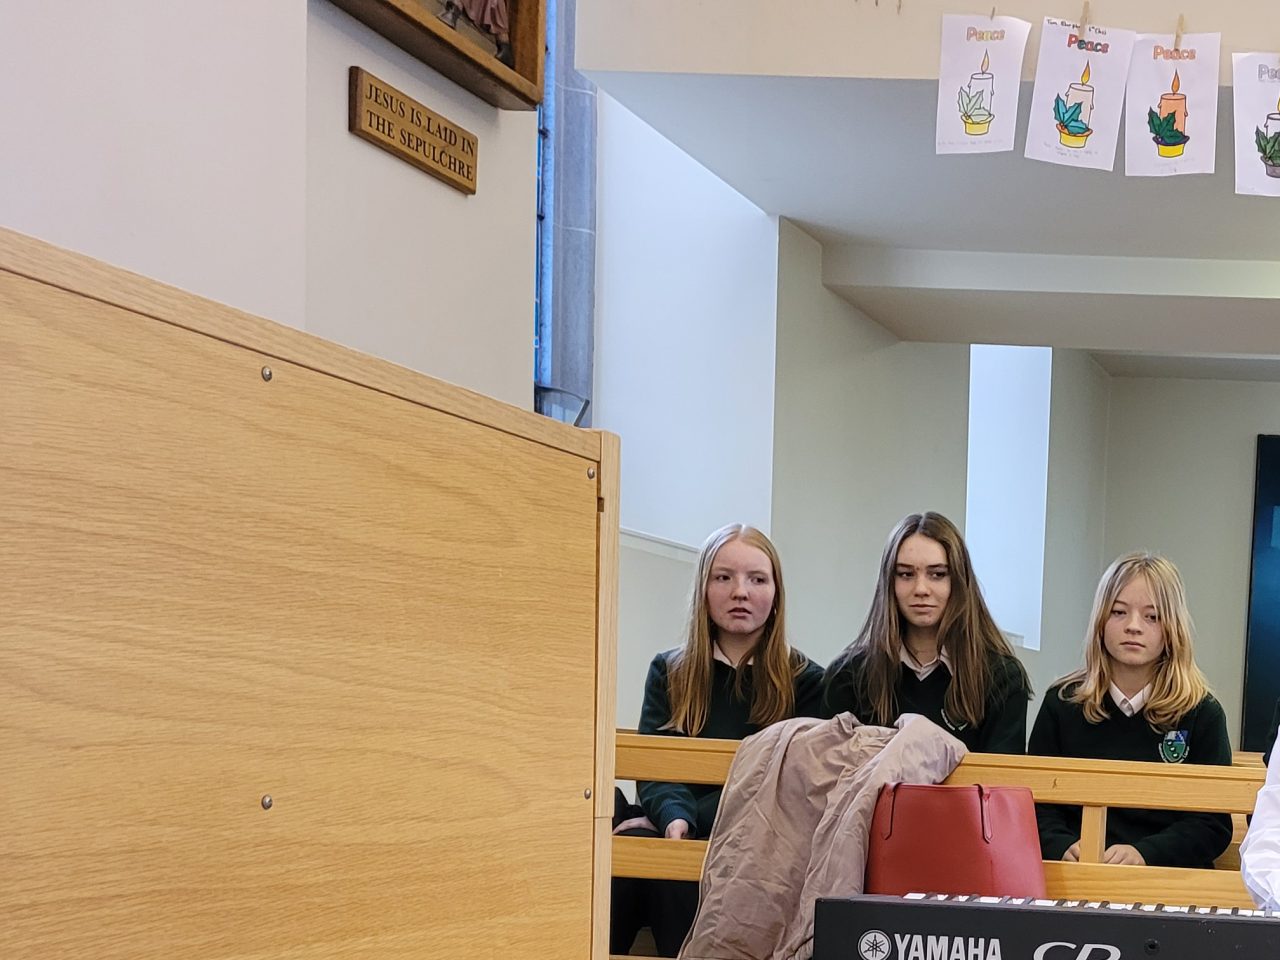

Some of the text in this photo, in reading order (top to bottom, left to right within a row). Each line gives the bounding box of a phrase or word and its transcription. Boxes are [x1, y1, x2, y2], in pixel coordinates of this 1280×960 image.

[966, 26, 1005, 41] Peace
[1067, 33, 1109, 54] Peace
[1153, 45, 1196, 60] Peace
[365, 84, 475, 157] JESUS IS LAID IN
[366, 109, 474, 181] THE SEPULCHRE
